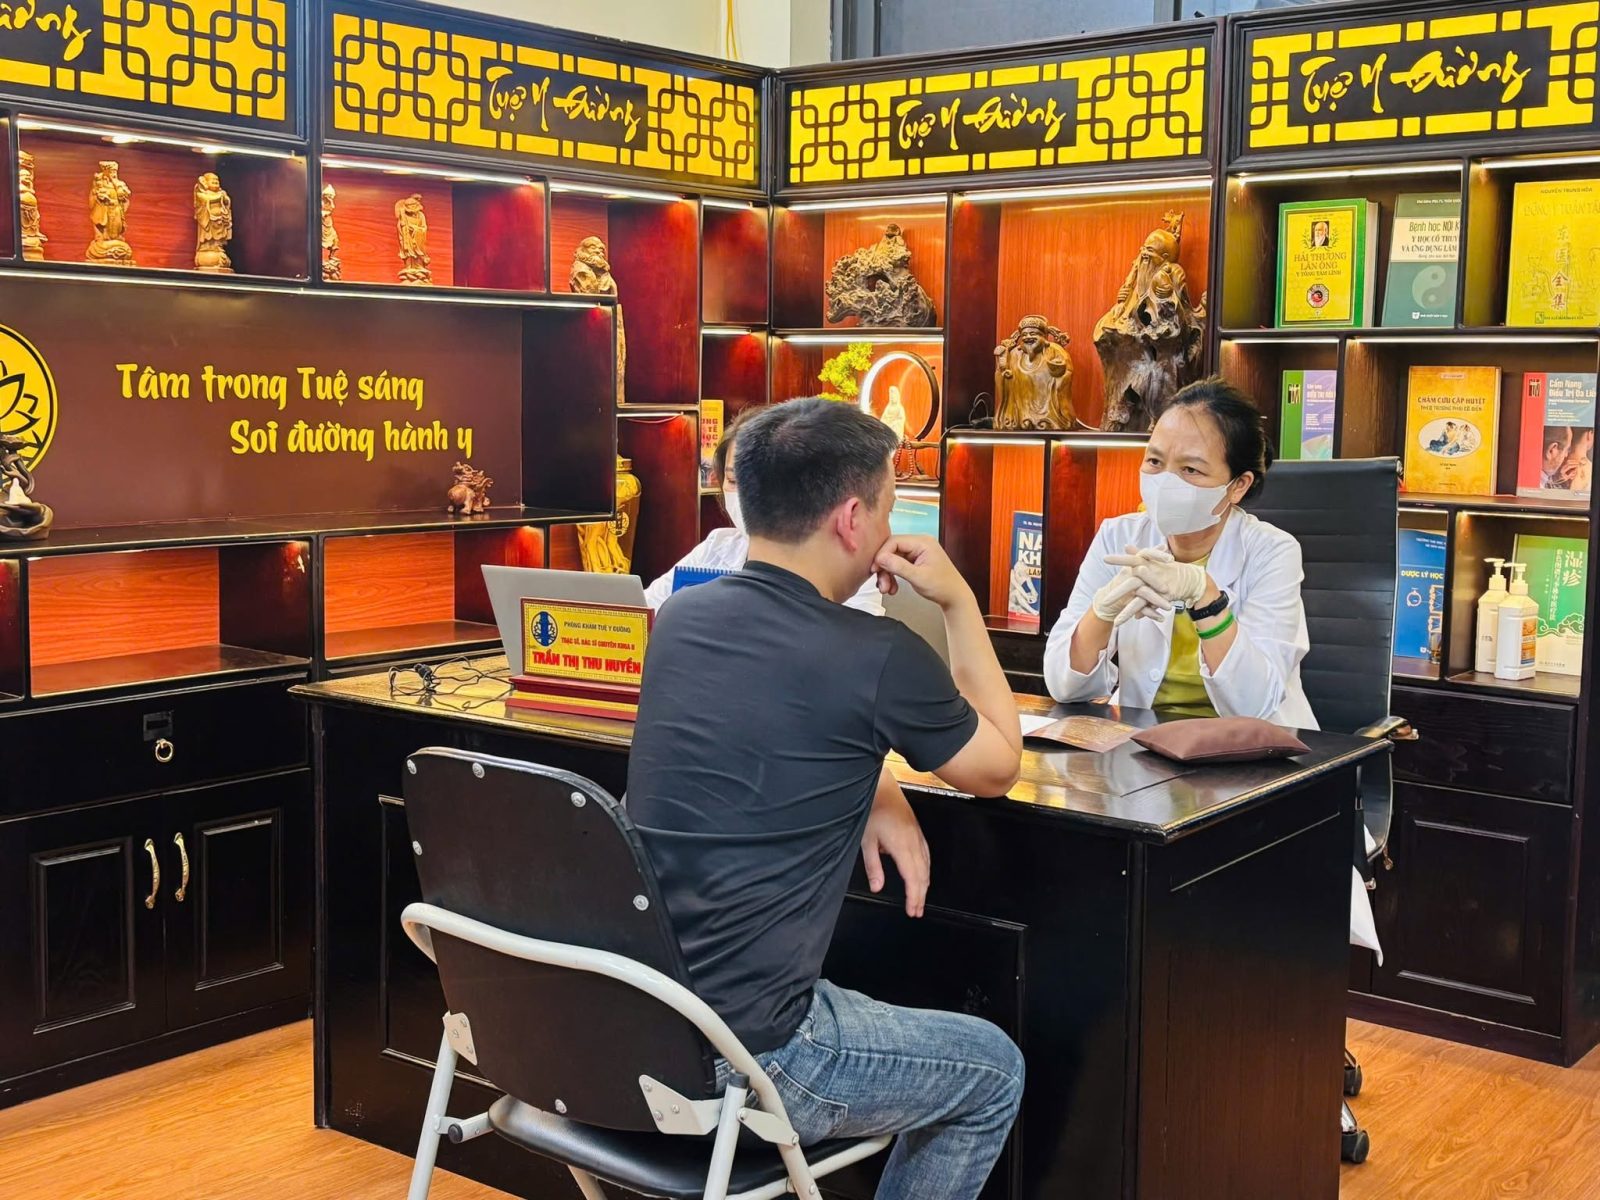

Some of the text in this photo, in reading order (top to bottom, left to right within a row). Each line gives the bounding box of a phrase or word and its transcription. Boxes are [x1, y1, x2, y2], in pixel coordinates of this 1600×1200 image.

[486, 66, 527, 121] Tuệ
[1301, 56, 1353, 113] Tuệ
[896, 100, 936, 149] Tuệ
[116, 363, 424, 410] Tâm trong Tuệ sáng
[230, 420, 473, 461] Soi đường hành y
[532, 649, 560, 666] TRẦN
[562, 654, 579, 671] THỊ
[582, 656, 602, 670] THU
